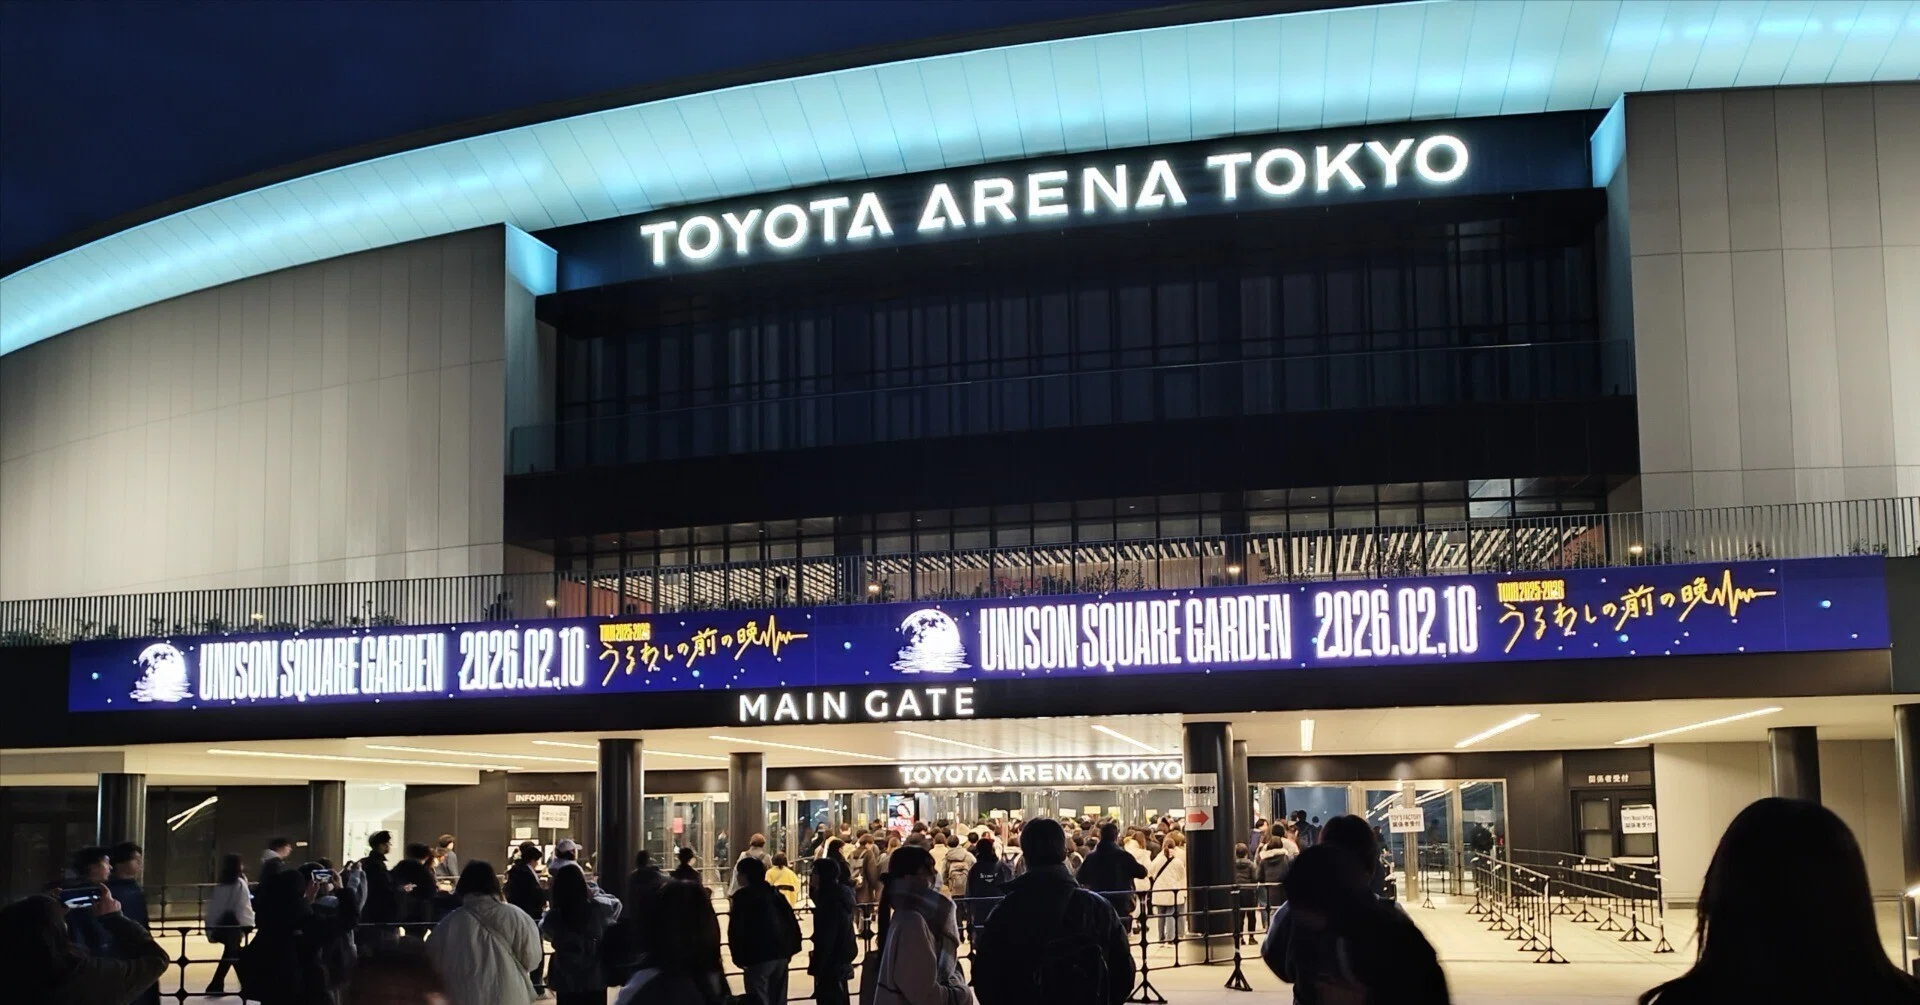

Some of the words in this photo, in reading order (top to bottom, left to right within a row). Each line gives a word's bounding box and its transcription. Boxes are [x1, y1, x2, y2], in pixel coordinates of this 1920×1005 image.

[640, 190, 894, 267] TOYOTA
[916, 158, 1188, 233] ARENA
[1206, 133, 1470, 200] TOKYO
[1497, 581, 1519, 602] TOUR
[1519, 579, 1565, 602] 2025-2026
[980, 604, 1077, 671] UNISON
[1081, 599, 1182, 672] SQUARE
[1186, 593, 1292, 664] GARDEN
[1314, 584, 1479, 659] 2026.02.10
[200, 639, 279, 700] UNISON
[280, 635, 359, 701] SQUARE
[361, 632, 445, 693] GARDEN
[459, 626, 586, 691] 2026.02.10
[738, 691, 848, 722] MAIN
[864, 687, 975, 718] GATE
[898, 765, 994, 785] TOYOTA
[999, 763, 1093, 783] ARENA
[1096, 761, 1183, 782] TOKYO
[515, 794, 575, 802] INFORMATION
